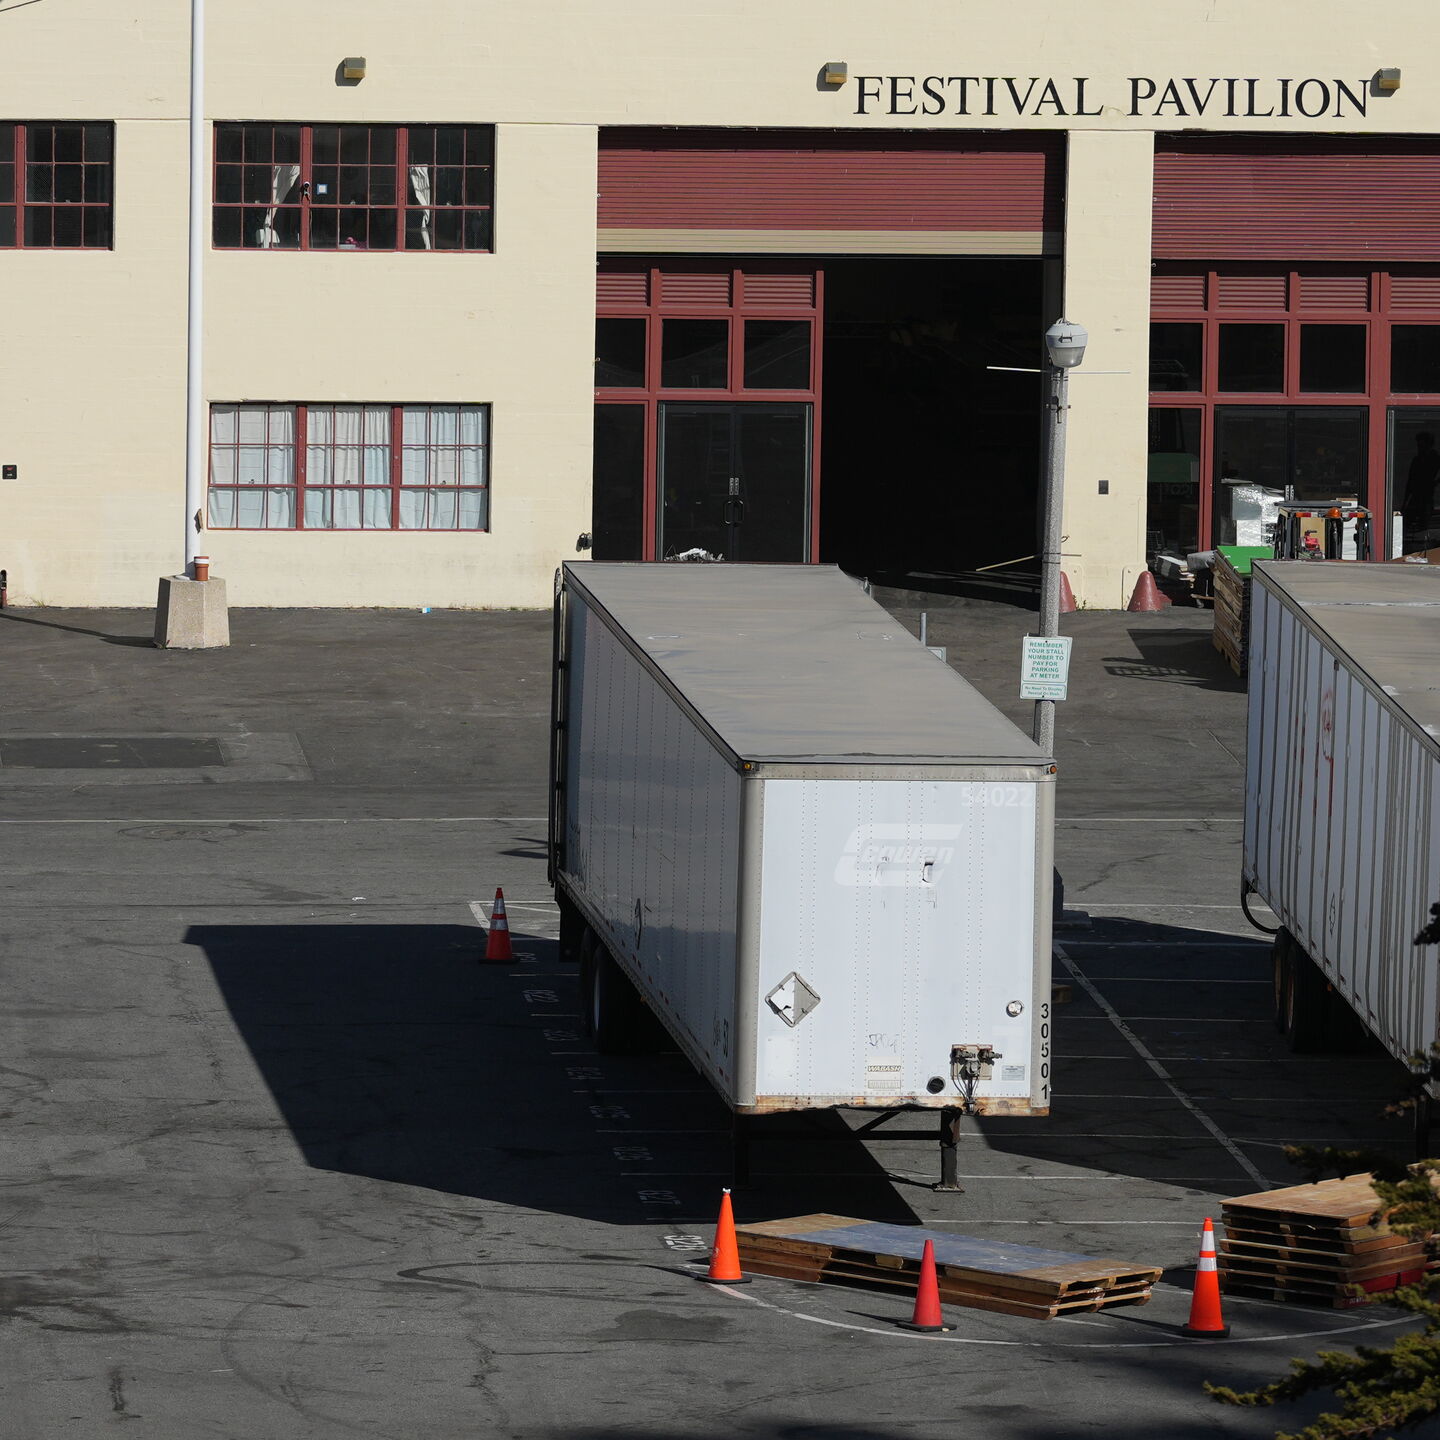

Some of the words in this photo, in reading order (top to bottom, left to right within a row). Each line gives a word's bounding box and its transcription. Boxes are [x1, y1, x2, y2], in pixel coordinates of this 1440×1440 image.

[853, 75, 1104, 116] FESTIVAL
[1128, 77, 1371, 119] PAVILION
[868, 1065, 902, 1073] WABASH
[1041, 1003, 1049, 1100] 30501
